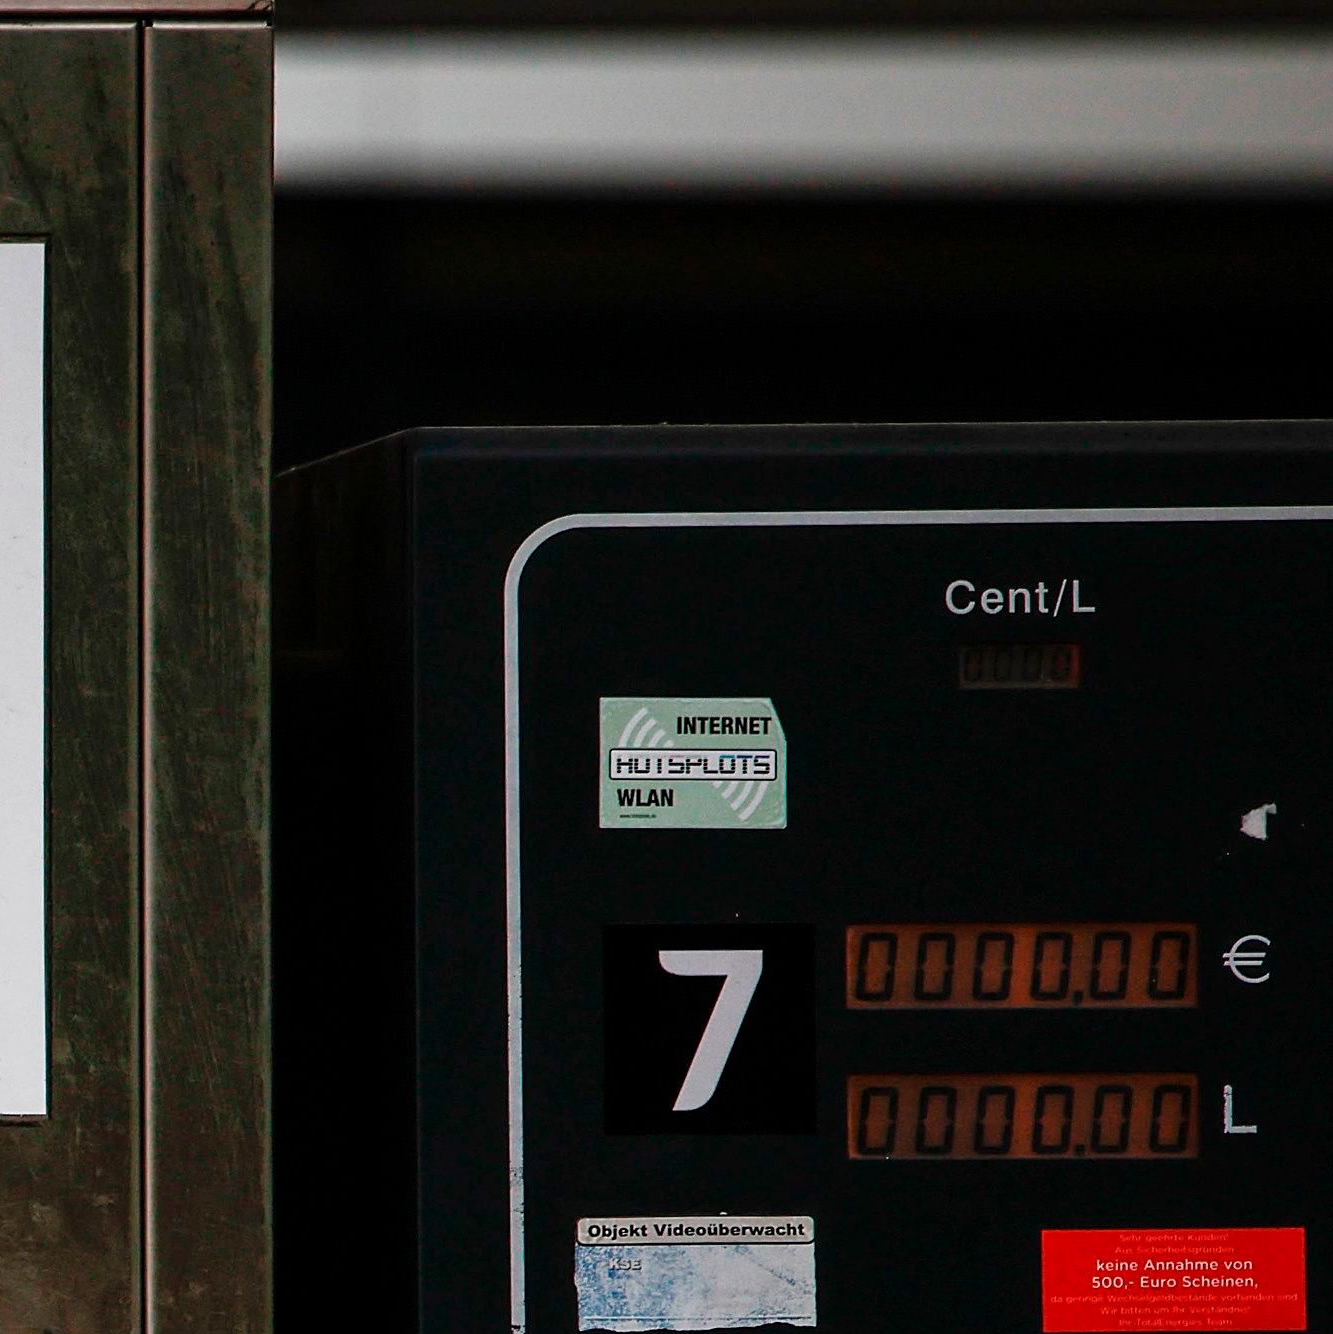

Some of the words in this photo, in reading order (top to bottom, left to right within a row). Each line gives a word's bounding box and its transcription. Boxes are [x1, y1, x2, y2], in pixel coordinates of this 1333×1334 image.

[946, 579, 1095, 617] Cent/L
[677, 717, 772, 734] INTERNET
[617, 789, 673, 806] WLAN
[1223, 935, 1271, 984] €
[659, 950, 763, 1111] 7
[1224, 1085, 1258, 1134] L
[588, 1224, 647, 1240] Objekt
[654, 1223, 804, 1237] Videoüberwacht
[1097, 1259, 1138, 1271] keine
[1144, 1258, 1218, 1271] Annahme
[1224, 1260, 1252, 1270] von
[1093, 1276, 1133, 1289] 500,-
[1141, 1276, 1176, 1288] Euro
[1183, 1275, 1258, 1289] Scheinen,
